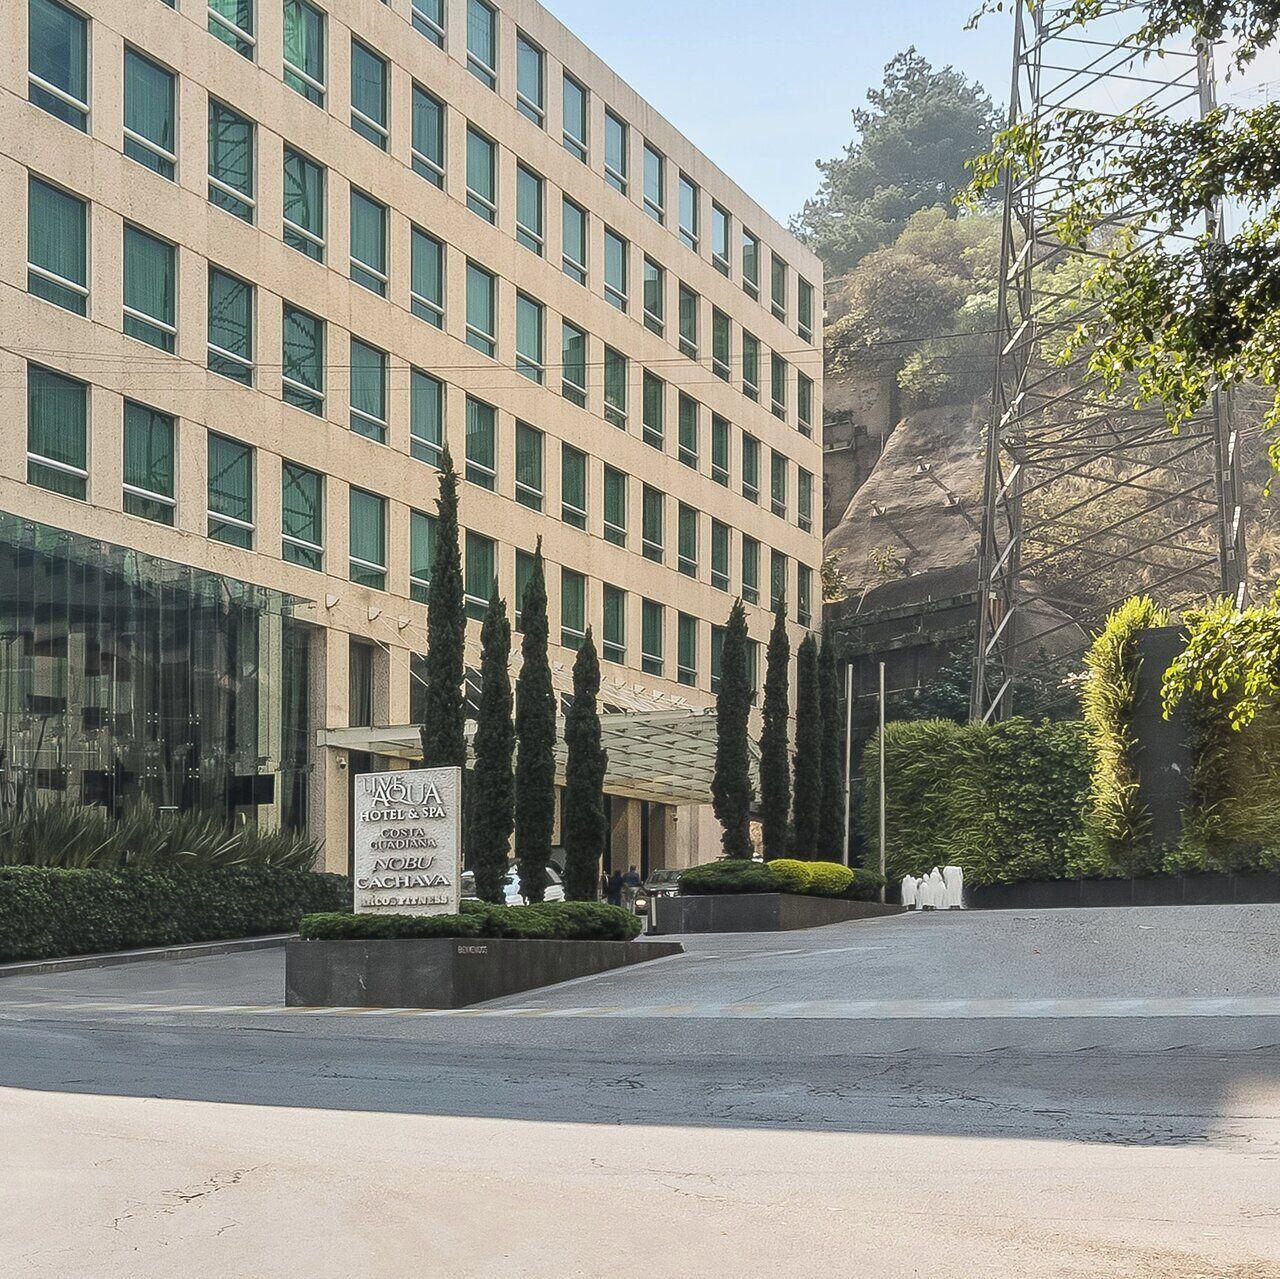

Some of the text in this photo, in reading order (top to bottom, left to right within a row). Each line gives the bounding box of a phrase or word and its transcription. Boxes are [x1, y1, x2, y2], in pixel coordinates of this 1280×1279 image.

[364, 776, 406, 794] LIVE
[371, 782, 443, 808] AQUA
[360, 807, 446, 821] HOTEL & SPA
[380, 828, 425, 839] COSTA
[370, 839, 437, 850] GUADIANA
[372, 856, 435, 874] NOBU
[356, 874, 451, 889] CACHAVA
